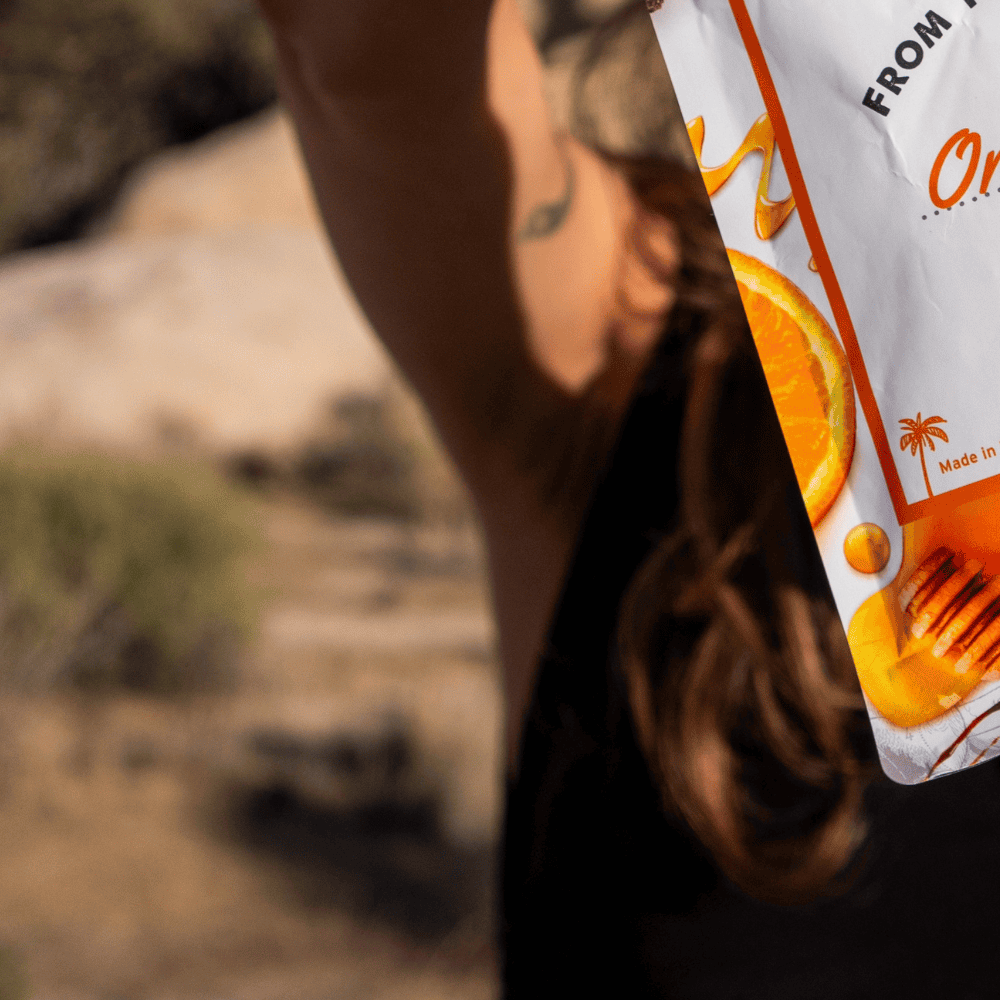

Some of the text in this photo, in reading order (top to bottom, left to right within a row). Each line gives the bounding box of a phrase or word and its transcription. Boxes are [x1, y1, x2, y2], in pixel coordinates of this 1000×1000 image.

[862, 10, 952, 117] FROM
[939, 452, 978, 474] Made
[981, 446, 997, 460] in
